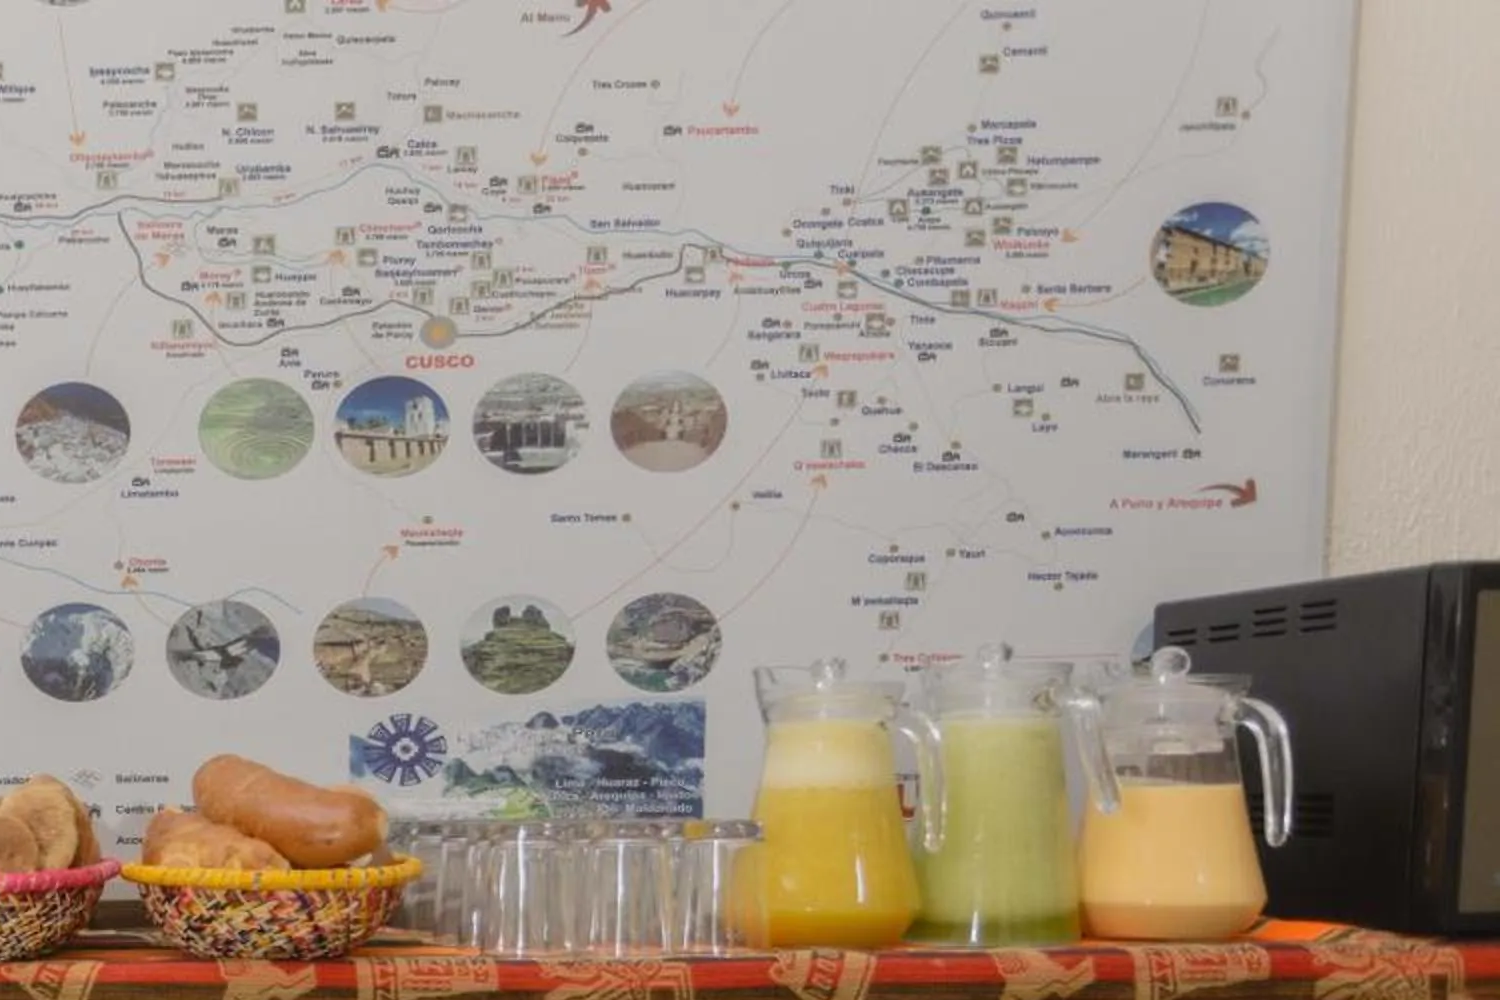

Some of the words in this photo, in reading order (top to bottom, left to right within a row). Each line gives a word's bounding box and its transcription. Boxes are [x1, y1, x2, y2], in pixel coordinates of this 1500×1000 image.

[408, 140, 438, 148] Calca
[405, 355, 475, 369] CUSCO
[1122, 499, 1154, 508] Puno
[1167, 499, 1223, 509] Arequipa
[960, 549, 986, 559] Yauri
